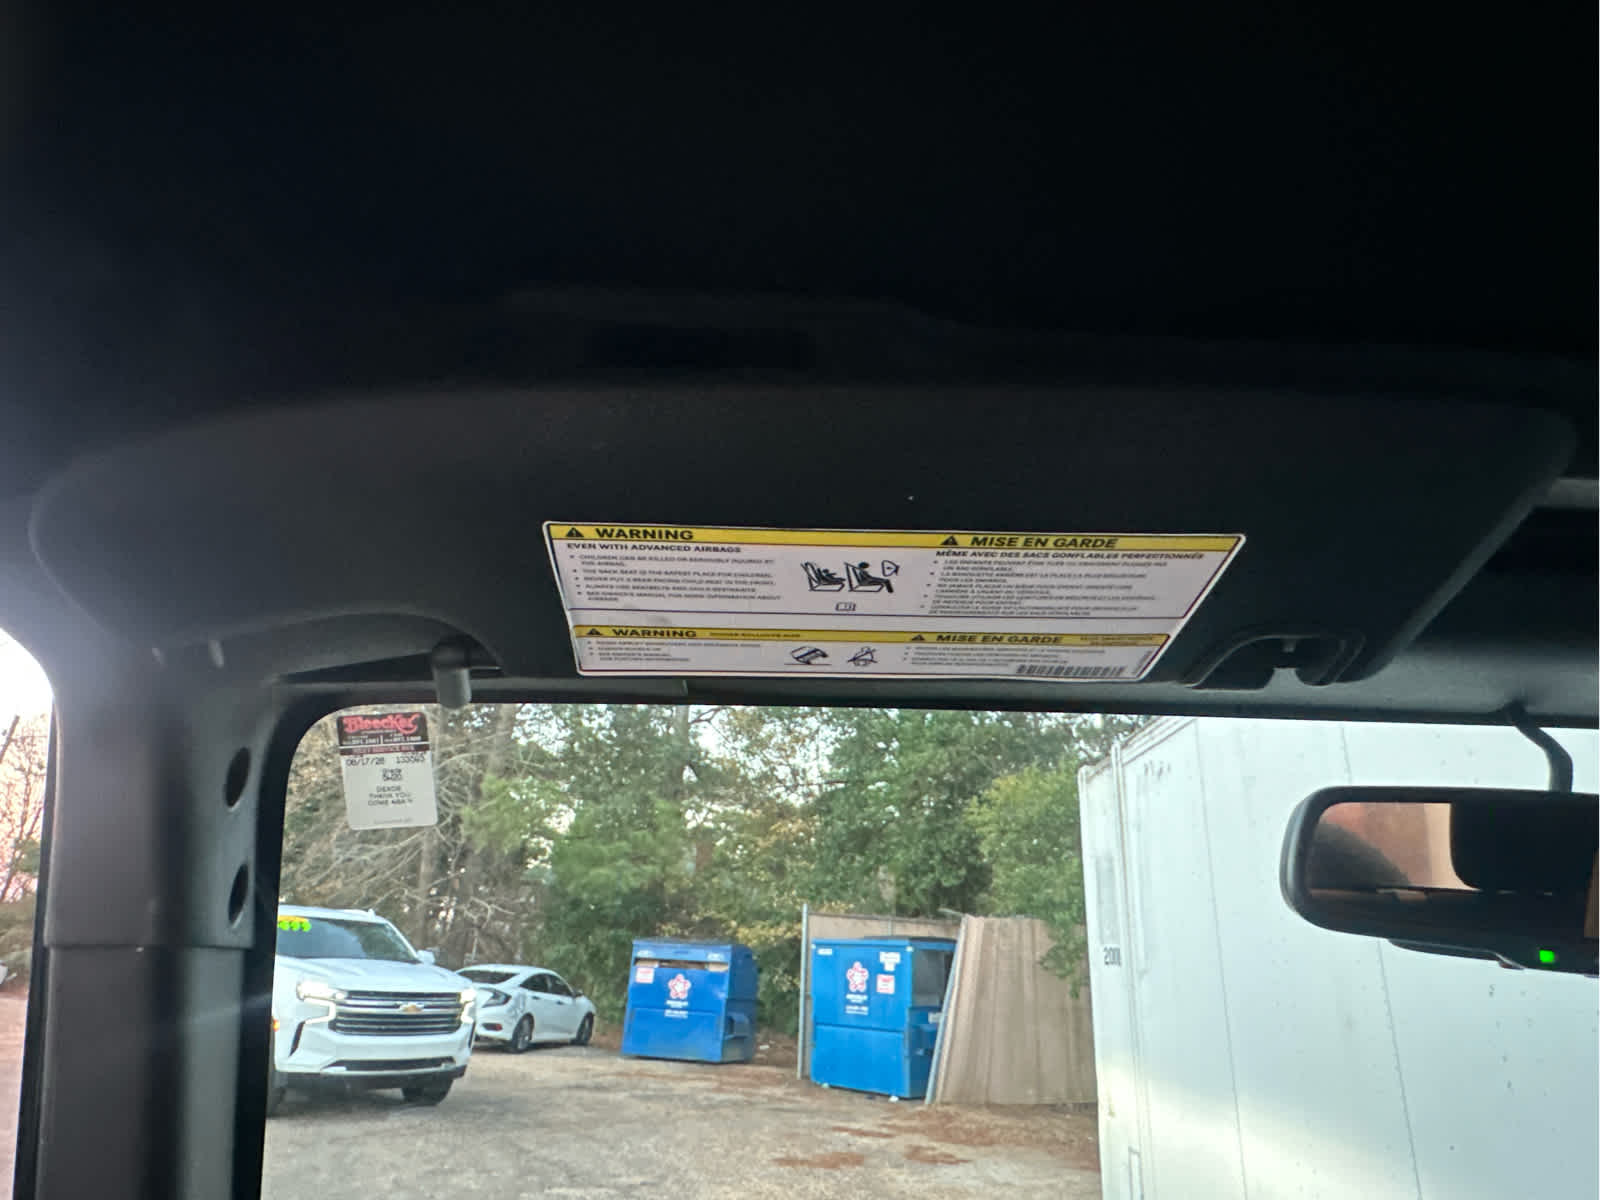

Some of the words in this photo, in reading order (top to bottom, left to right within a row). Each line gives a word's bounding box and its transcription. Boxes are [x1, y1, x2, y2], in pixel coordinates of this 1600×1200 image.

[596, 527, 694, 541] WARNING
[970, 536, 1020, 547] MISE
[1023, 537, 1049, 547] EN
[1052, 538, 1118, 548] GARDE
[599, 543, 628, 551] WITH
[631, 544, 691, 552] ADVANCED
[694, 545, 741, 553] AIRBAGS
[612, 629, 696, 637] WARNING
[936, 634, 977, 642] MISE
[981, 635, 1003, 643] EN
[1007, 635, 1064, 643] GARDE
